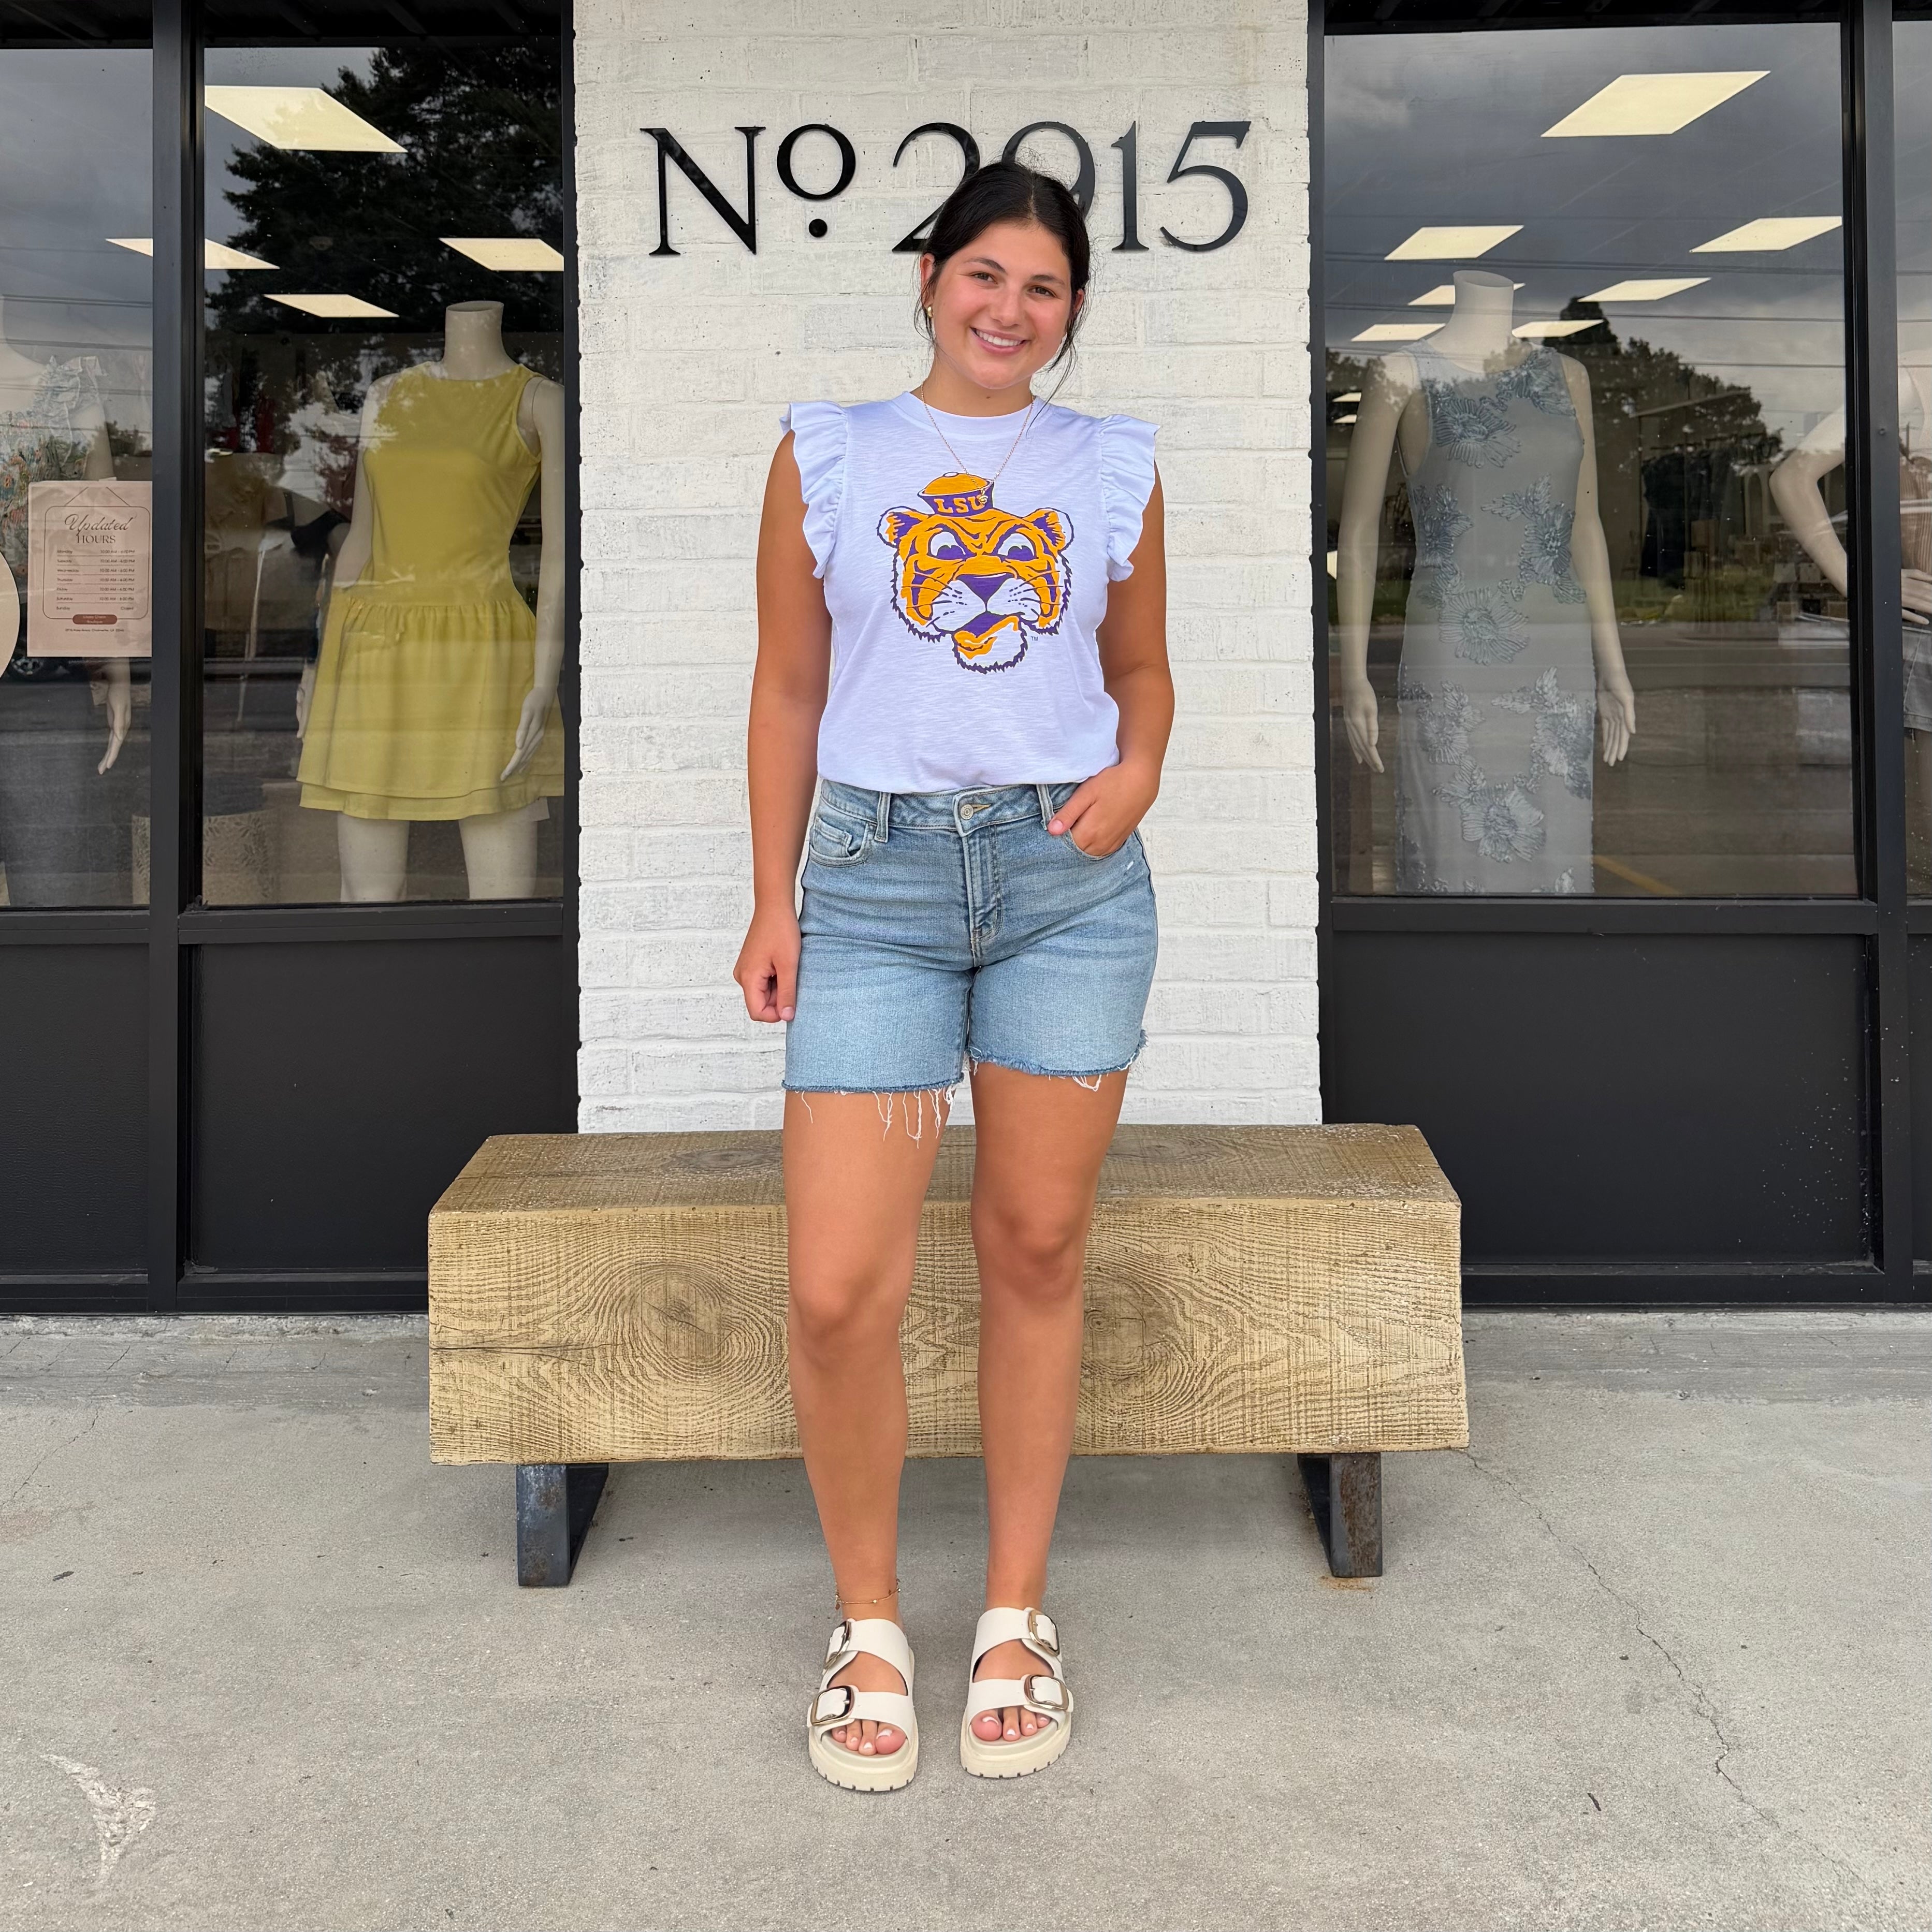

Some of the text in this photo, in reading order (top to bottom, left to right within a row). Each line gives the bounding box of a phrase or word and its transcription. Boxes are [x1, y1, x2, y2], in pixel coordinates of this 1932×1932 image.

[934, 495, 987, 513] LSU
[64, 514, 134, 536] Updated
[76, 534, 116, 544] HOURS
